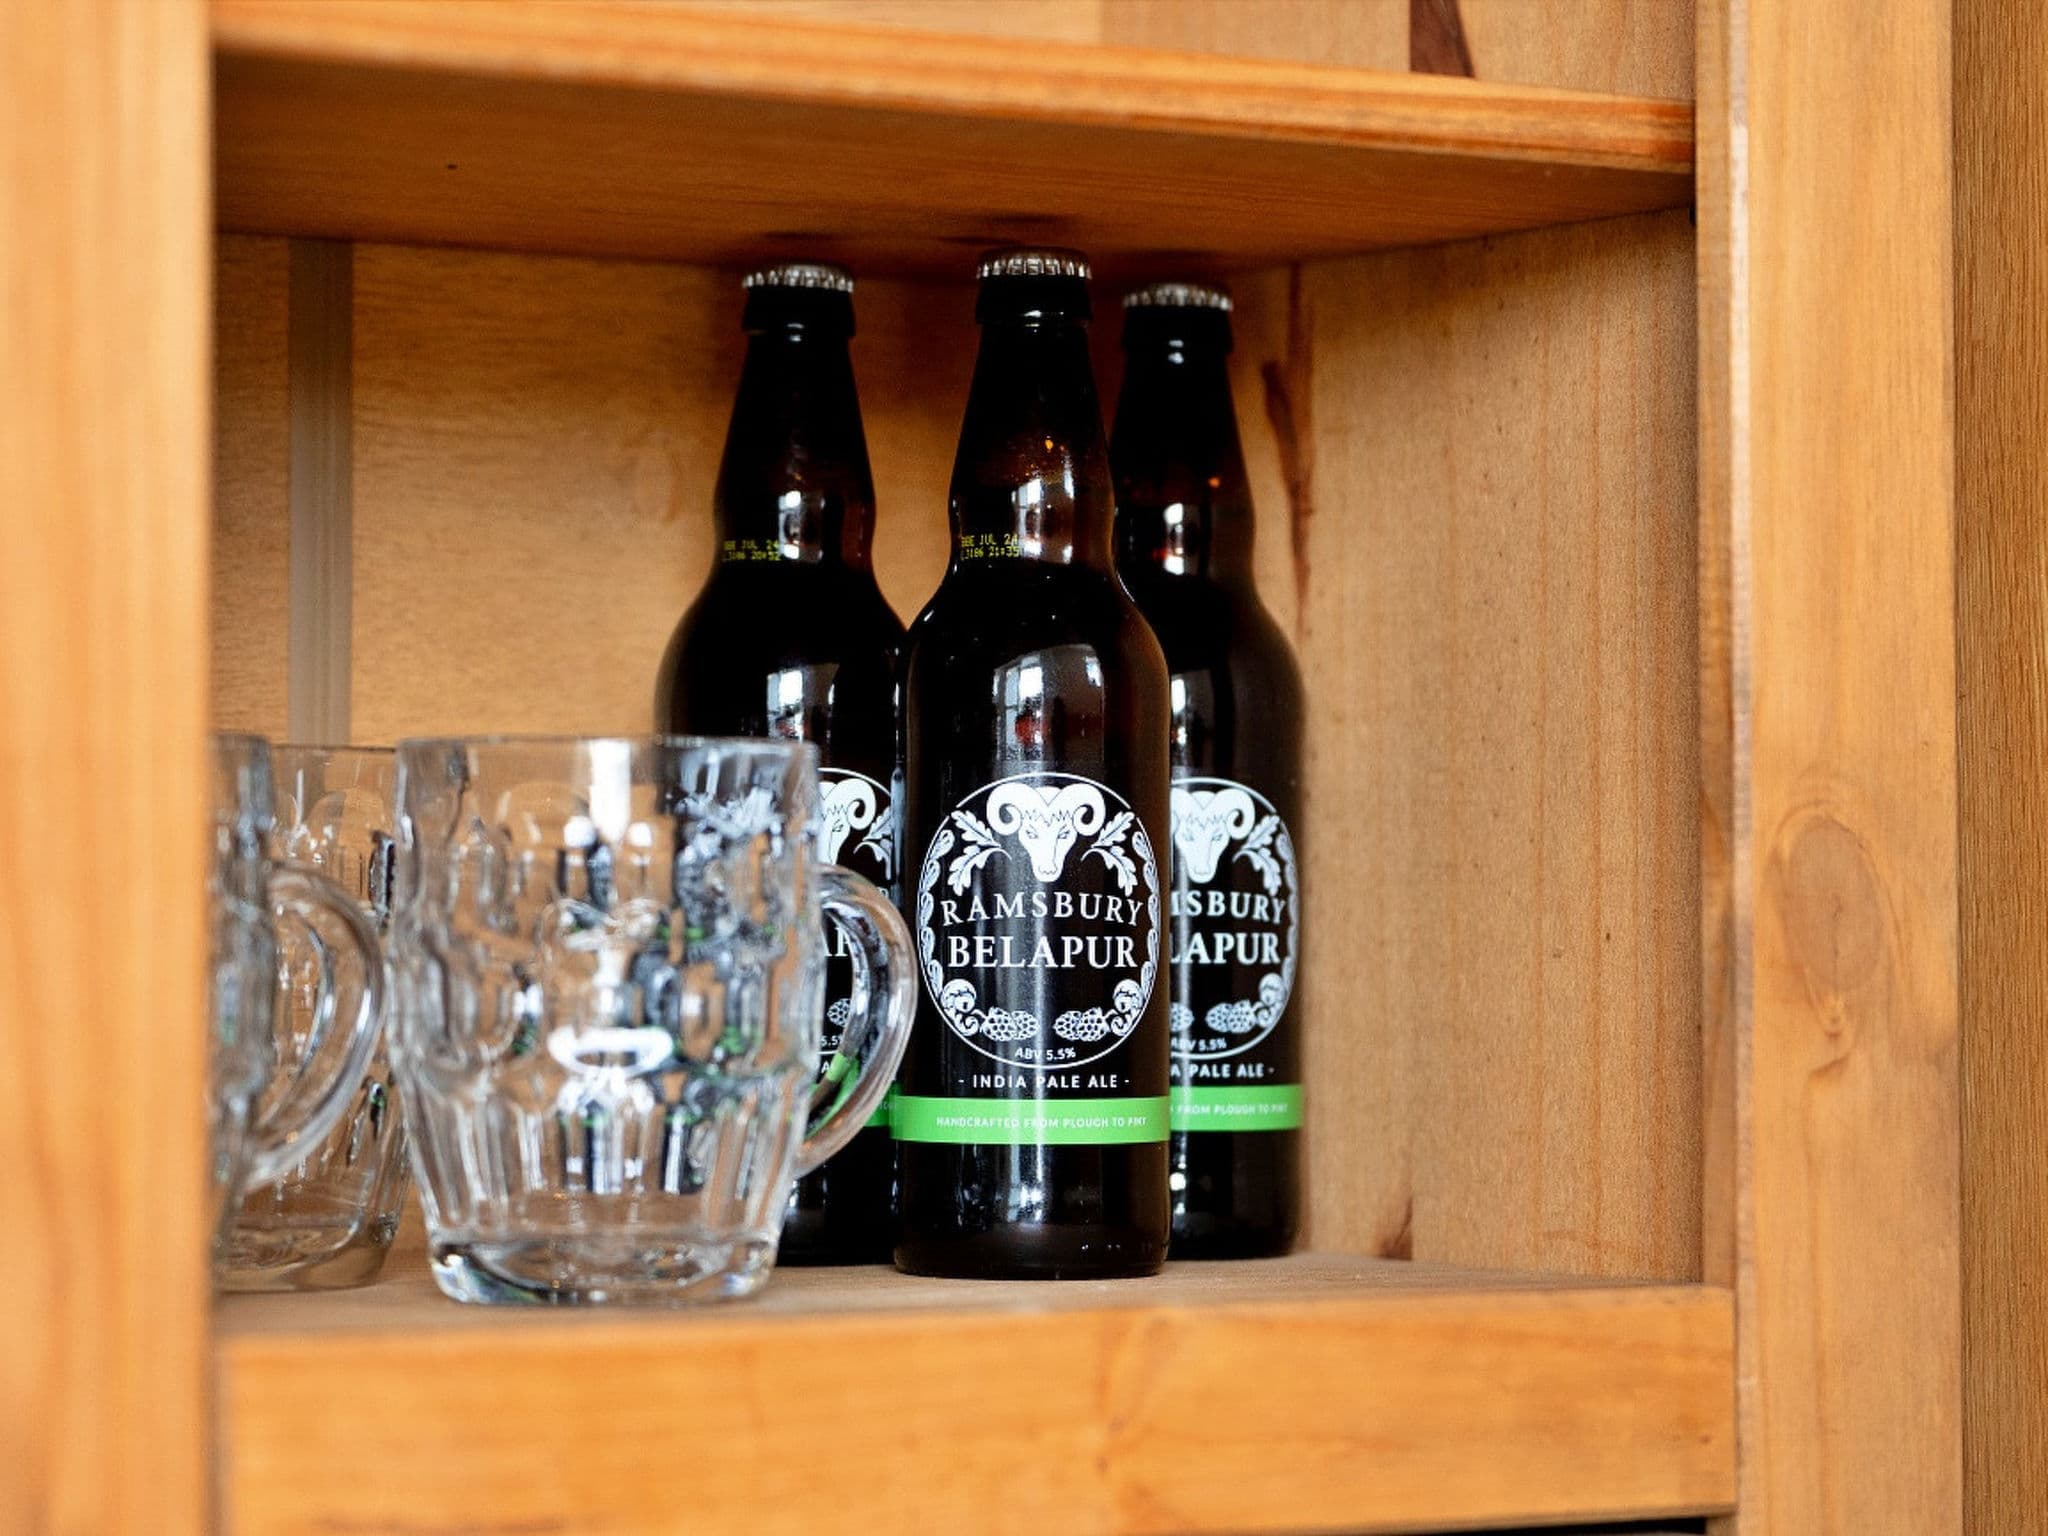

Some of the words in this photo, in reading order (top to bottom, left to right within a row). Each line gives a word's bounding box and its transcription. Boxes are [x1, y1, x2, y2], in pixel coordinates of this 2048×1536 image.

[979, 533, 997, 546] JUL
[1003, 533, 1018, 546] 24
[940, 891, 1143, 927] RAMSBURY
[1171, 890, 1286, 924] SBURY
[948, 936, 1138, 968] BELAPUR
[1170, 932, 1280, 964] APUR
[1198, 1037, 1227, 1051] 5.5%
[1014, 1046, 1041, 1060] ABV
[1046, 1046, 1076, 1060] 5.5%
[1188, 1063, 1231, 1078] PALE
[1236, 1063, 1265, 1078] ALE
[973, 1074, 1026, 1089] INDIA
[1036, 1074, 1080, 1089] PALE
[1088, 1074, 1118, 1089] ALE
[1178, 1104, 1210, 1115] FROM
[936, 1116, 1020, 1128] HANDCRAFTED
[1023, 1117, 1058, 1128] FROM
[1063, 1117, 1108, 1128] PLOUGH
[1112, 1117, 1125, 1127] TO
